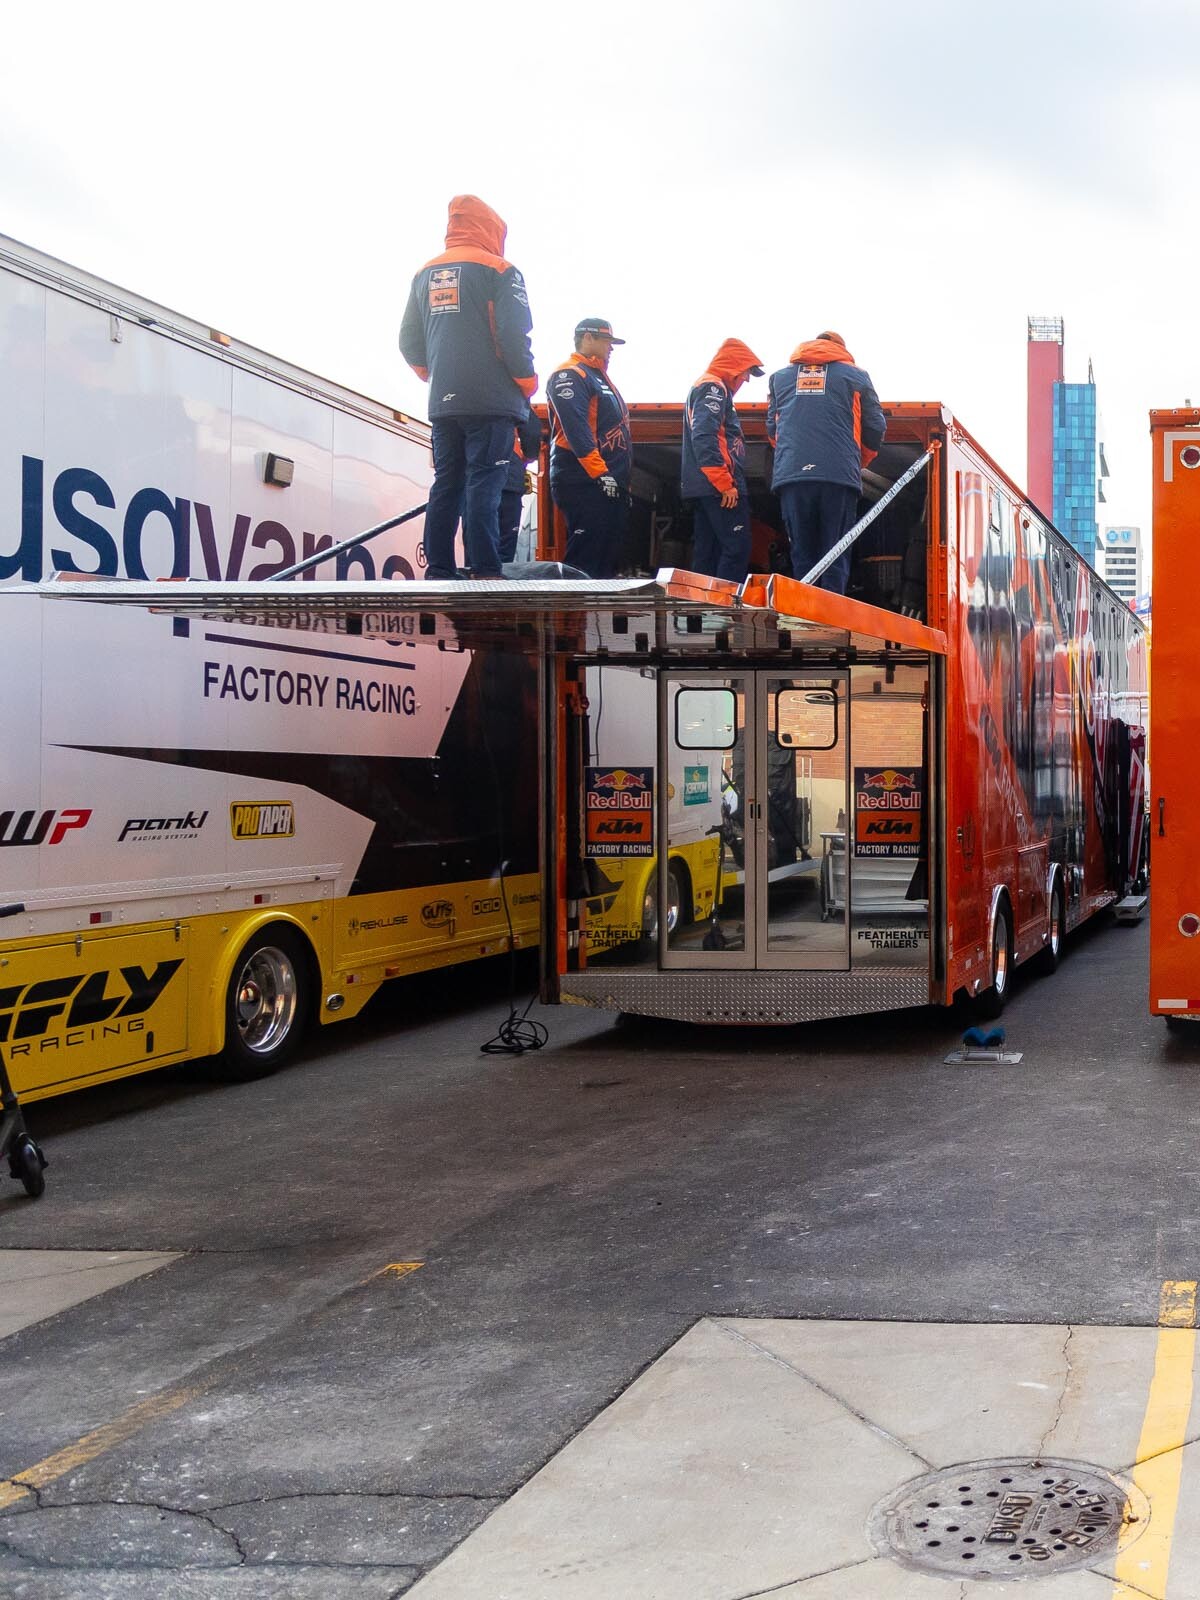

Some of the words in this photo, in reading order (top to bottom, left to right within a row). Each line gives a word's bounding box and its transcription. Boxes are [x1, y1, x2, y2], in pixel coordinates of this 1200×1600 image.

[203, 661, 331, 707] FACTORY
[336, 681, 416, 715] RACING
[587, 791, 619, 809] Red
[620, 791, 652, 809] Bull
[856, 792, 889, 809] Red
[890, 792, 921, 809] Bull
[0, 808, 93, 847] WP
[596, 818, 644, 834] KTM
[865, 818, 913, 835] KTM
[587, 844, 620, 854] FACTORY
[622, 844, 652, 854] RACING
[856, 844, 890, 854] FACTORY
[858, 930, 931, 940] FEATHERLITE
[870, 940, 918, 949] TRAILERS
[11, 1018, 144, 1060] RACING
